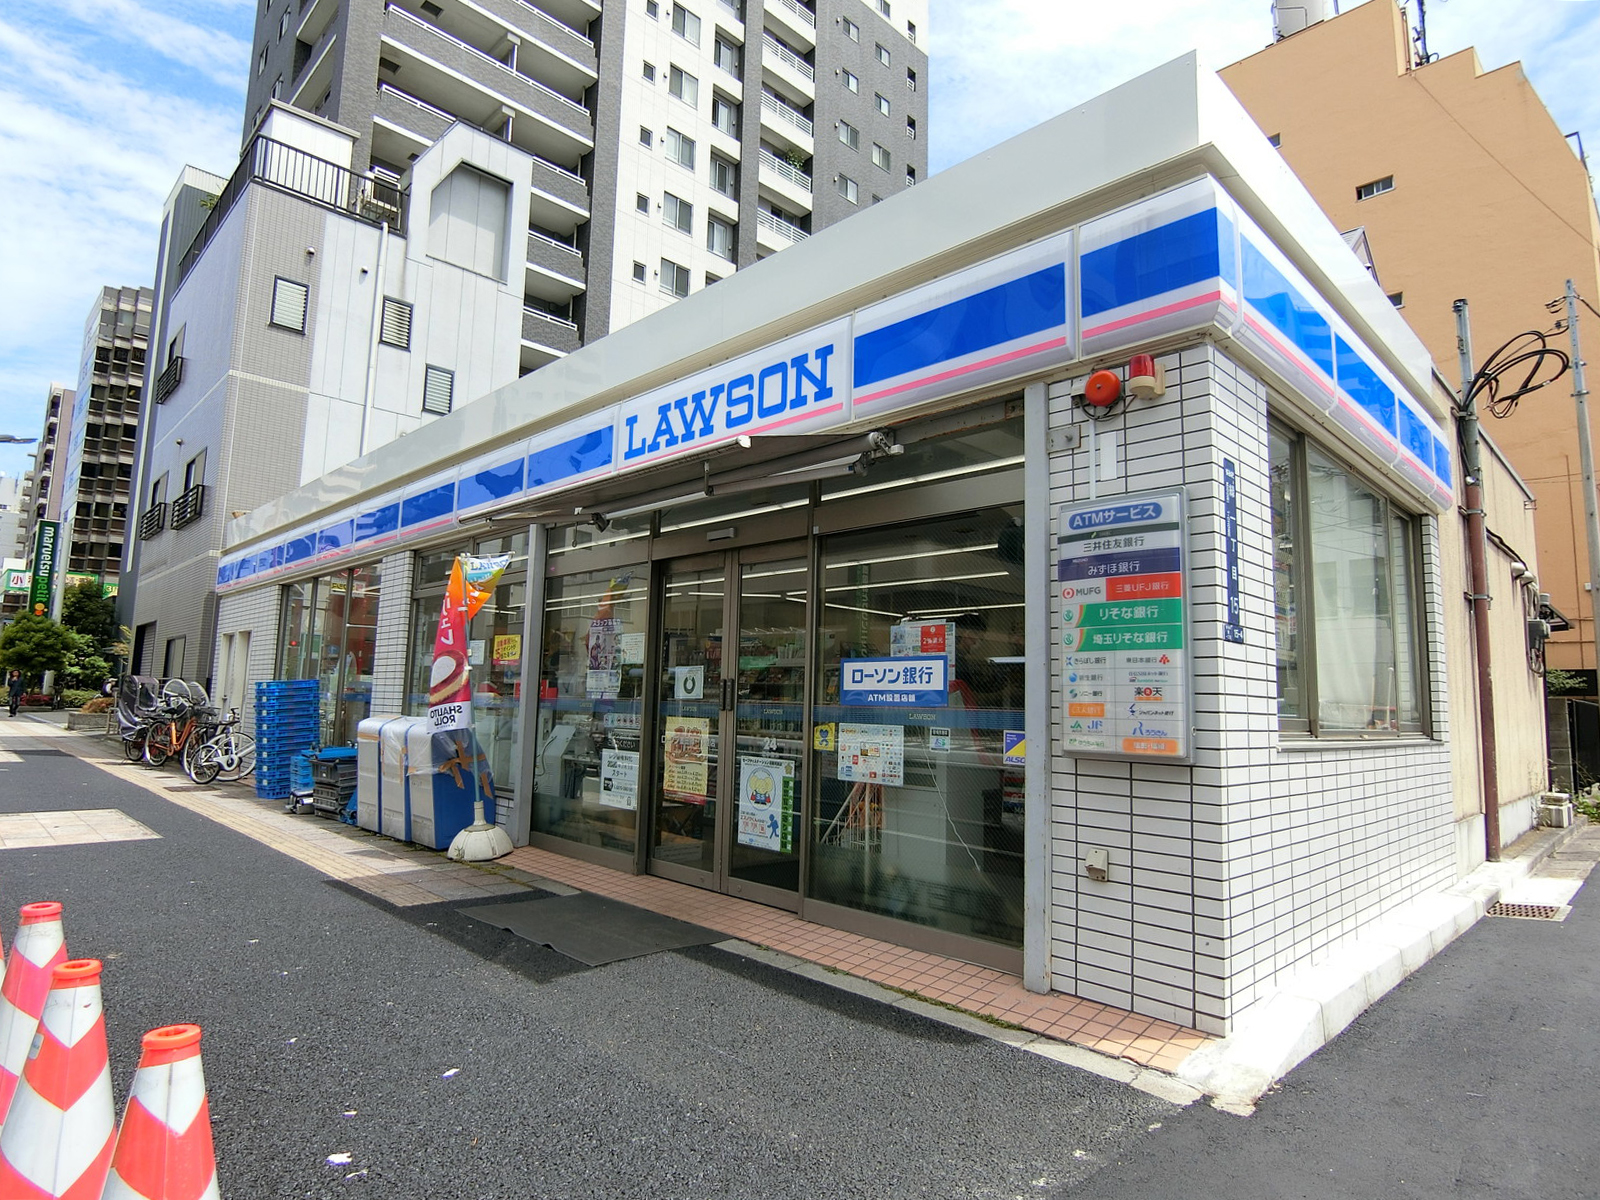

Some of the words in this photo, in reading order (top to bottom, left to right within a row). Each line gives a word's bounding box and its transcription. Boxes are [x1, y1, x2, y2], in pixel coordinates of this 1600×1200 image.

[624, 343, 834, 460] LAWSON
[1073, 505, 1156, 527] ATMサービス
[1083, 535, 1145, 552] 三井住友銀行
[41, 526, 55, 576] maruetsu
[470, 559, 508, 570] LAWSO
[1088, 561, 1140, 575] みずほ銀行
[35, 575, 49, 602] petit
[1076, 587, 1101, 596] MUFG
[1116, 581, 1169, 593] 三菱UFJ銀行
[1099, 605, 1159, 620] りそな銀行
[1093, 631, 1168, 645] 埼玉りそな銀行
[1074, 656, 1106, 665] きらぼし銀行
[852, 666, 933, 684] ローソン銀行
[867, 693, 916, 702] ATM設置店舗
[763, 737, 777, 750] 24
